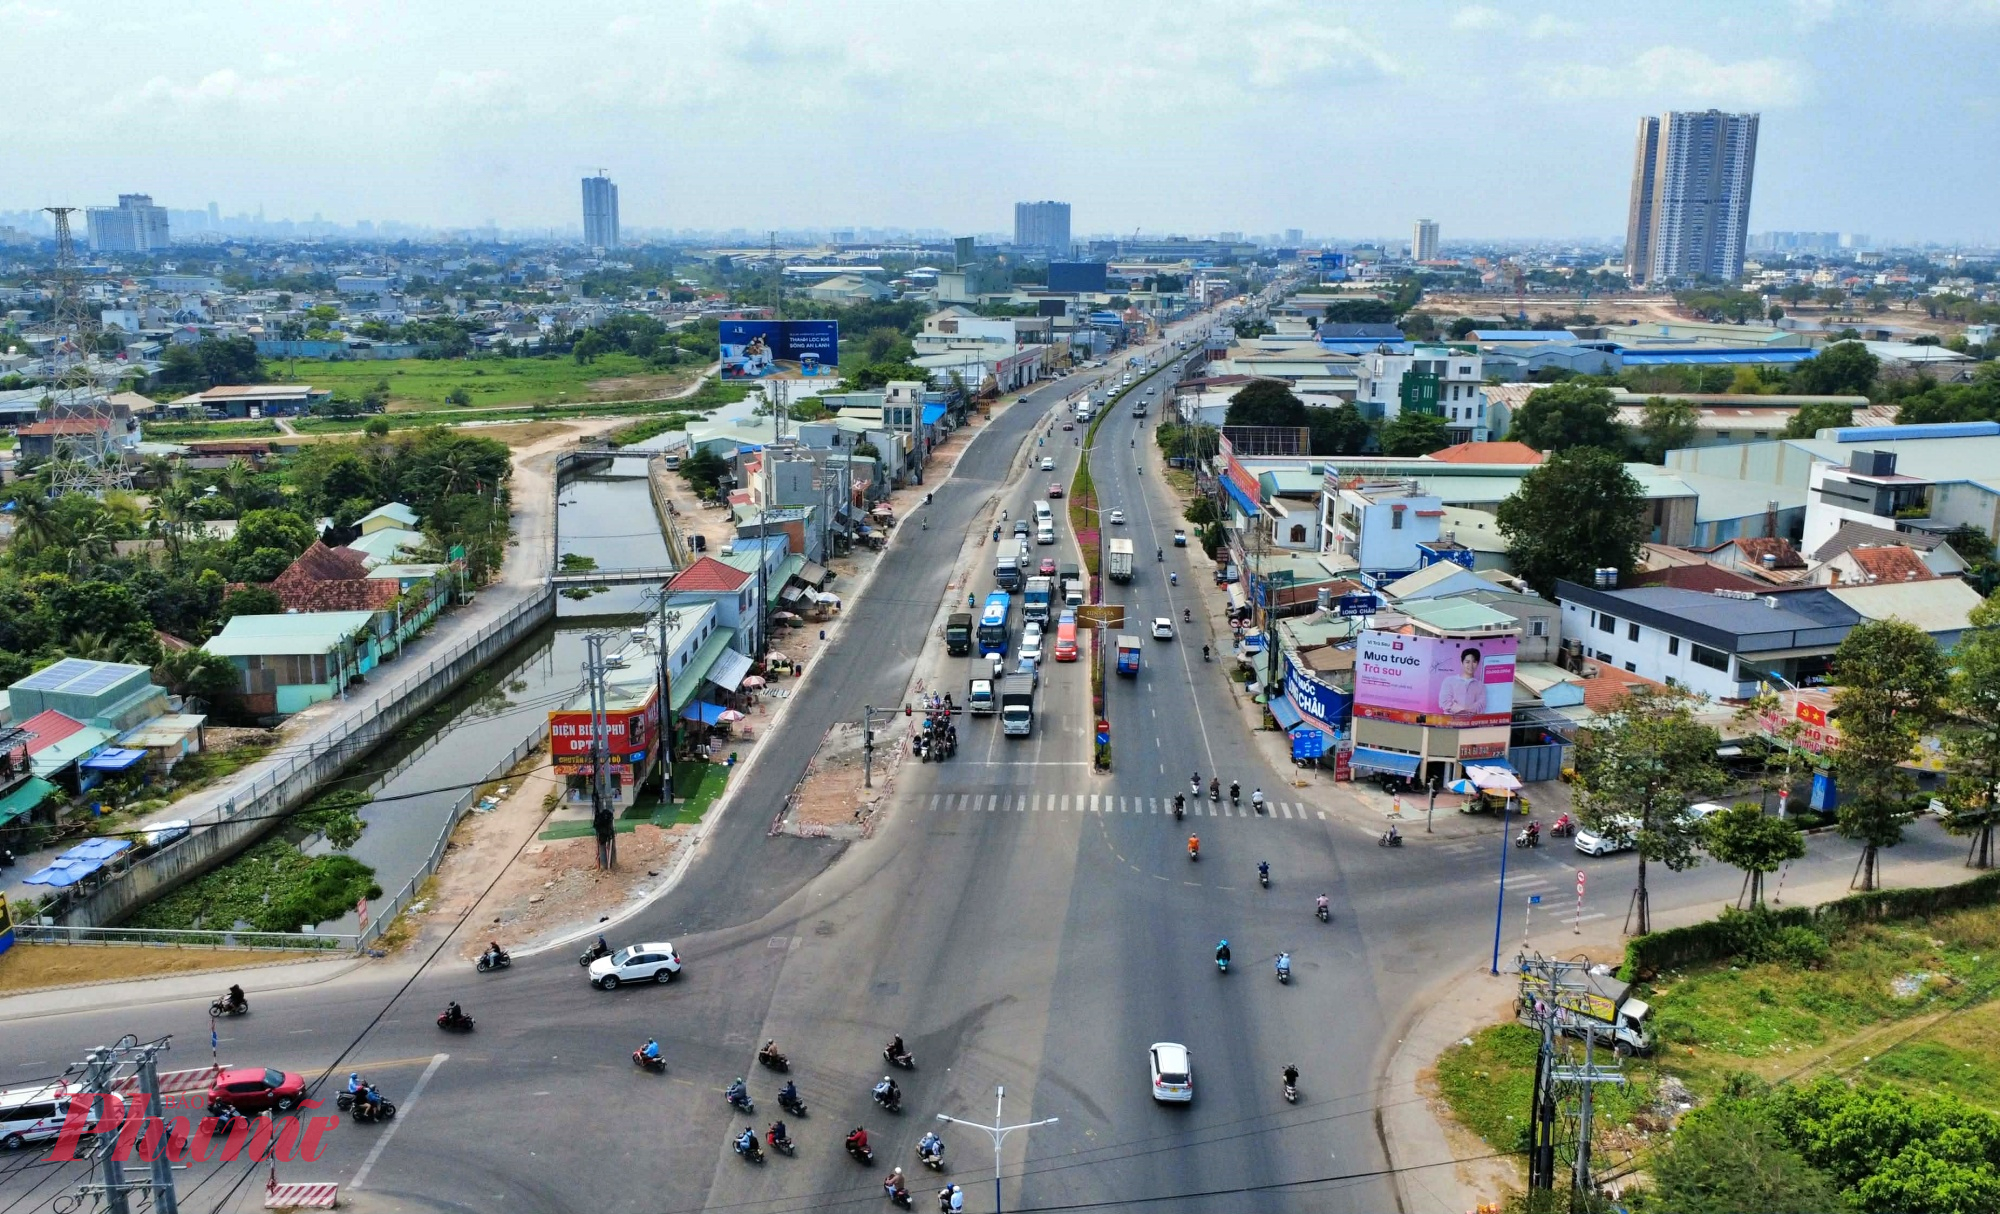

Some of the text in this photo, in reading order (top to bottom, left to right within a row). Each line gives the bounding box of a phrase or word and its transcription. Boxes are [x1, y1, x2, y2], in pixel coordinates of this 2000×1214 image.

[1364, 650, 1420, 666] Mua trước
[1363, 663, 1402, 676] Trả sau
[1299, 692, 1325, 718] CHÂU
[552, 723, 575, 738] ĐIỆN
[606, 721, 625, 735] PHỦ
